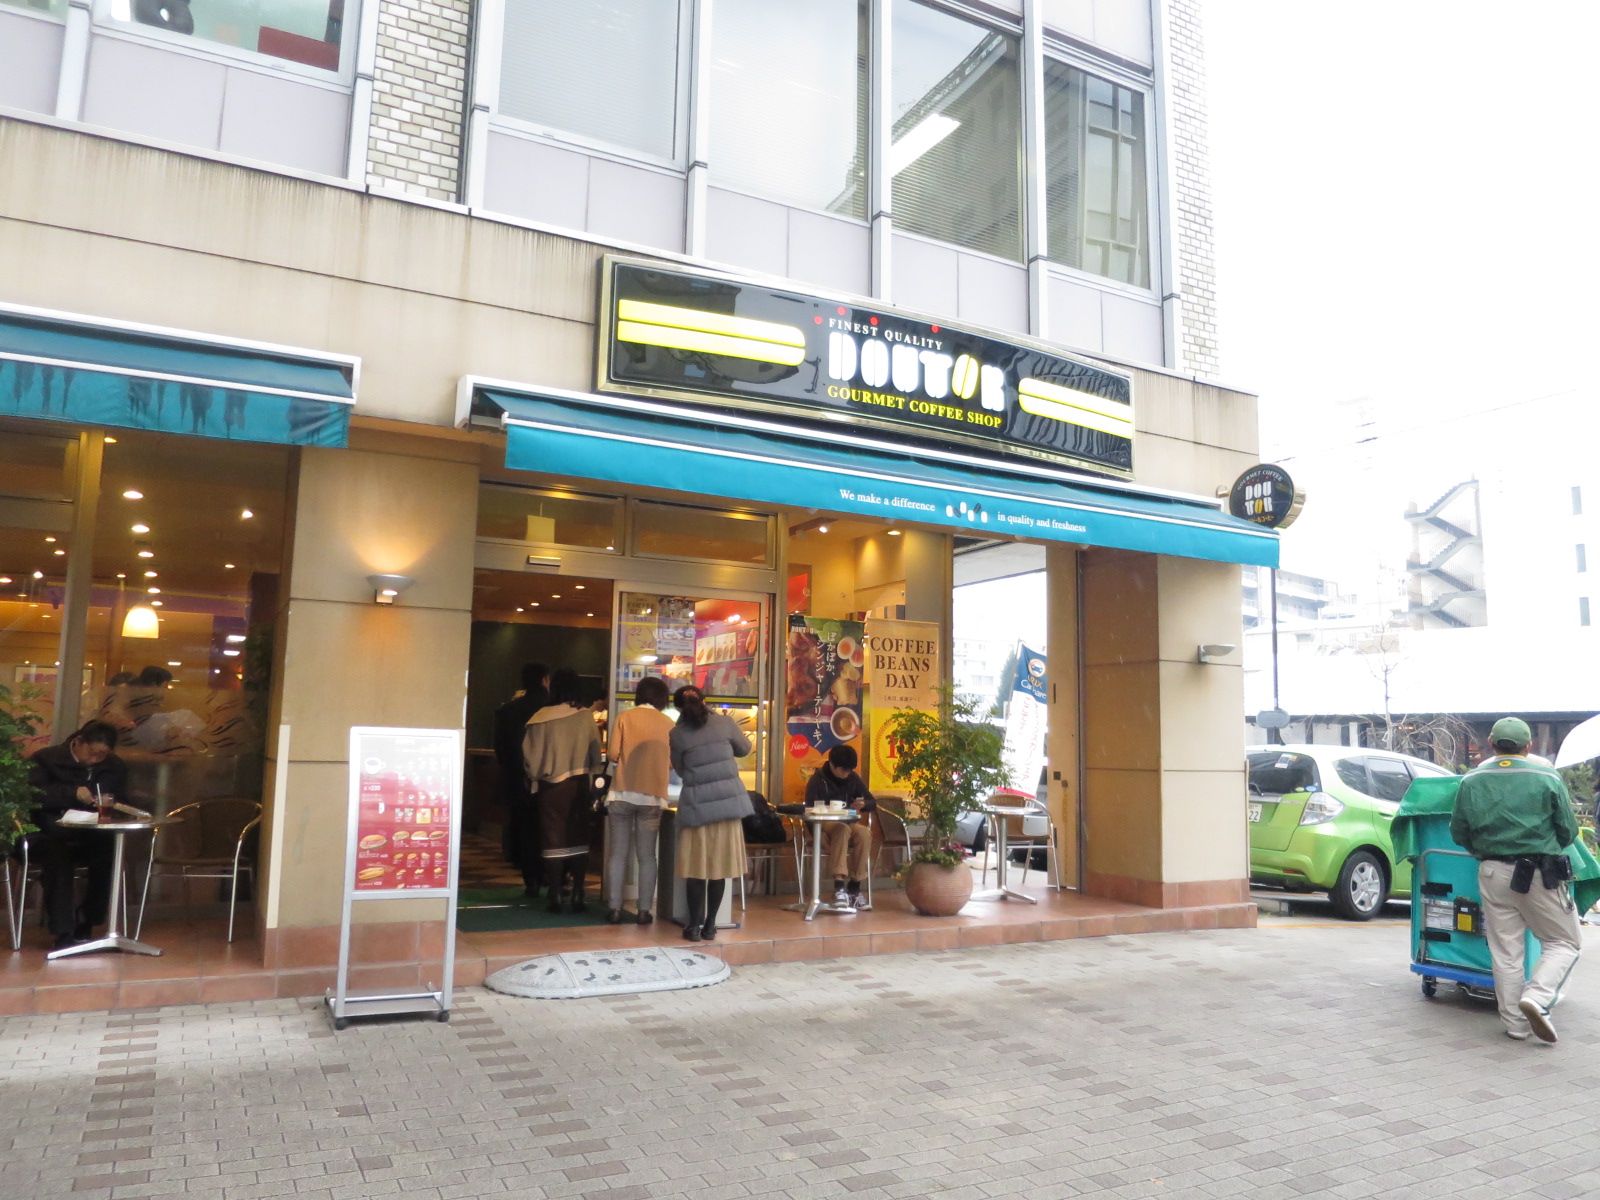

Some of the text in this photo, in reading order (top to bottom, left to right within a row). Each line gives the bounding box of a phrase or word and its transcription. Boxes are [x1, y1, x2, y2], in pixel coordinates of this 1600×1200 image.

[829, 318, 943, 350] FINEST QUALITY
[828, 331, 1006, 412] DOUTOR
[827, 385, 1002, 428] GOURMET COFFEE SHOP
[839, 489, 855, 500] We
[857, 493, 882, 504] make
[891, 496, 936, 512] difference
[1245, 481, 1272, 500] DOU
[1244, 496, 1273, 516] TOR
[997, 511, 1087, 533] in quality and freshness
[870, 636, 936, 655] COFFEE
[875, 654, 930, 673] BEANS
[885, 673, 920, 689] DAY
[790, 740, 809, 752] New
